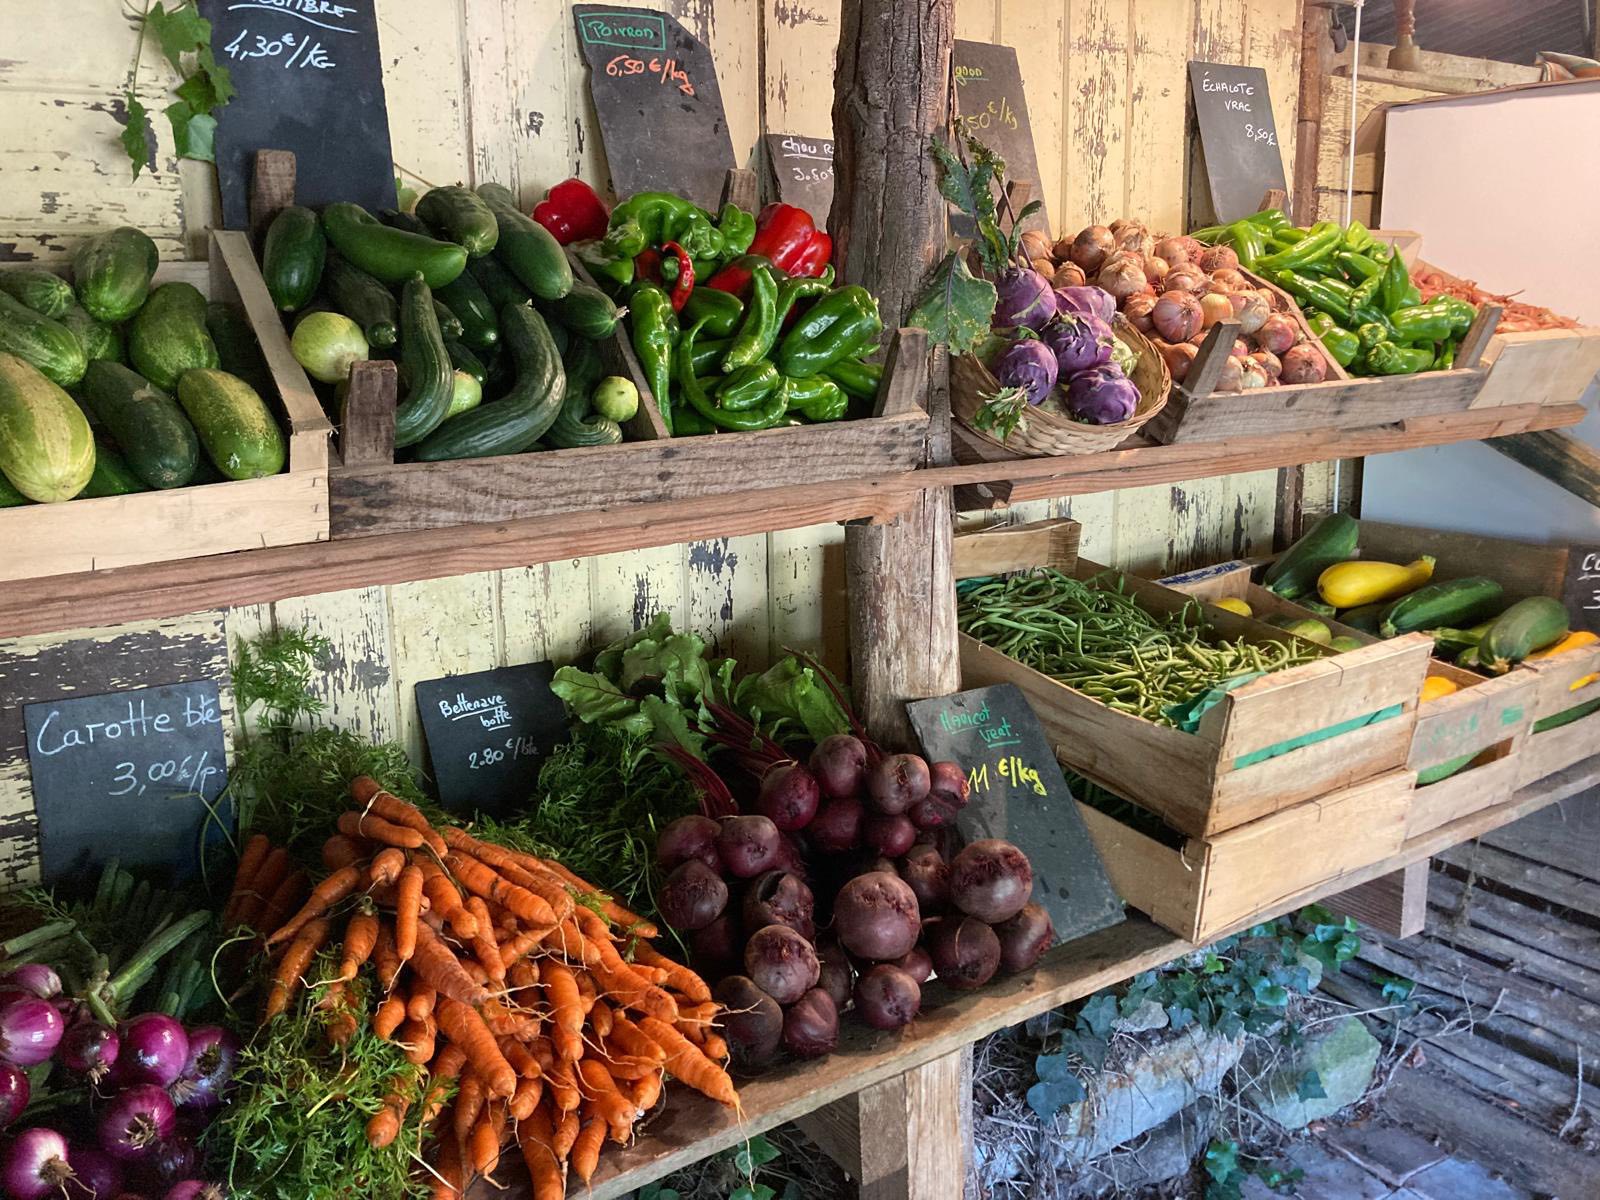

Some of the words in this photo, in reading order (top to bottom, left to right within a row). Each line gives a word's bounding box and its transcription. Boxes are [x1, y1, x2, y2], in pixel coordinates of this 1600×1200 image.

[1225, 100, 1252, 112] VRAC
[781, 137, 817, 153] Chou
[480, 705, 512, 727] botte
[36, 699, 175, 755] Carotte
